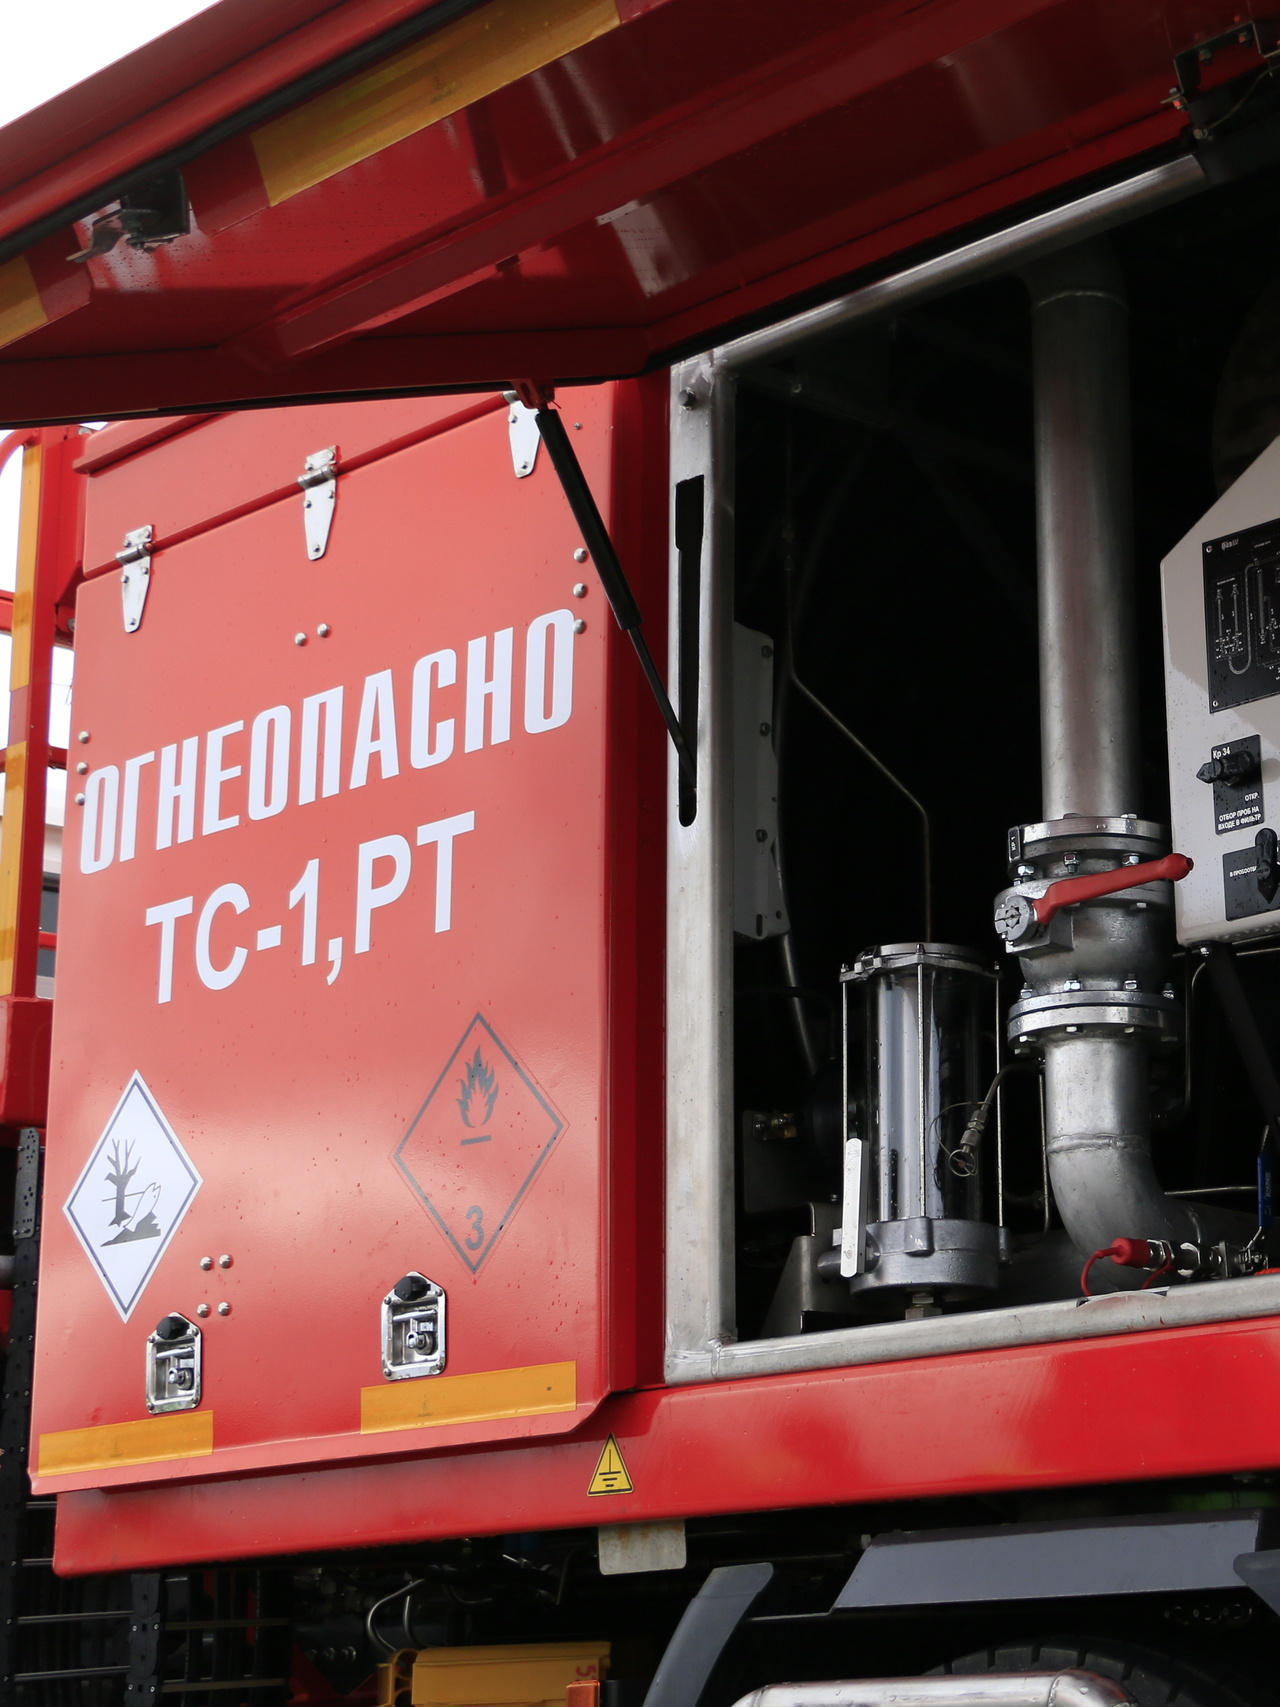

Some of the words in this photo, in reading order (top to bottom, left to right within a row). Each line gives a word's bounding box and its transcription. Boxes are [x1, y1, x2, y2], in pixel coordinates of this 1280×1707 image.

[80, 608, 576, 876] ОГНЕОПАСНО
[1213, 749, 1222, 761] Кр
[1222, 746, 1231, 757] 34
[1218, 820, 1236, 831] ВХОДЕ
[1240, 813, 1262, 826] ФИЛЬТР
[1219, 811, 1237, 822] ОТБОР
[1237, 808, 1251, 818] ПРОБ
[1251, 805, 1260, 813] НА
[146, 811, 477, 1006] ТС-1,РТ
[465, 1204, 486, 1252] 3
